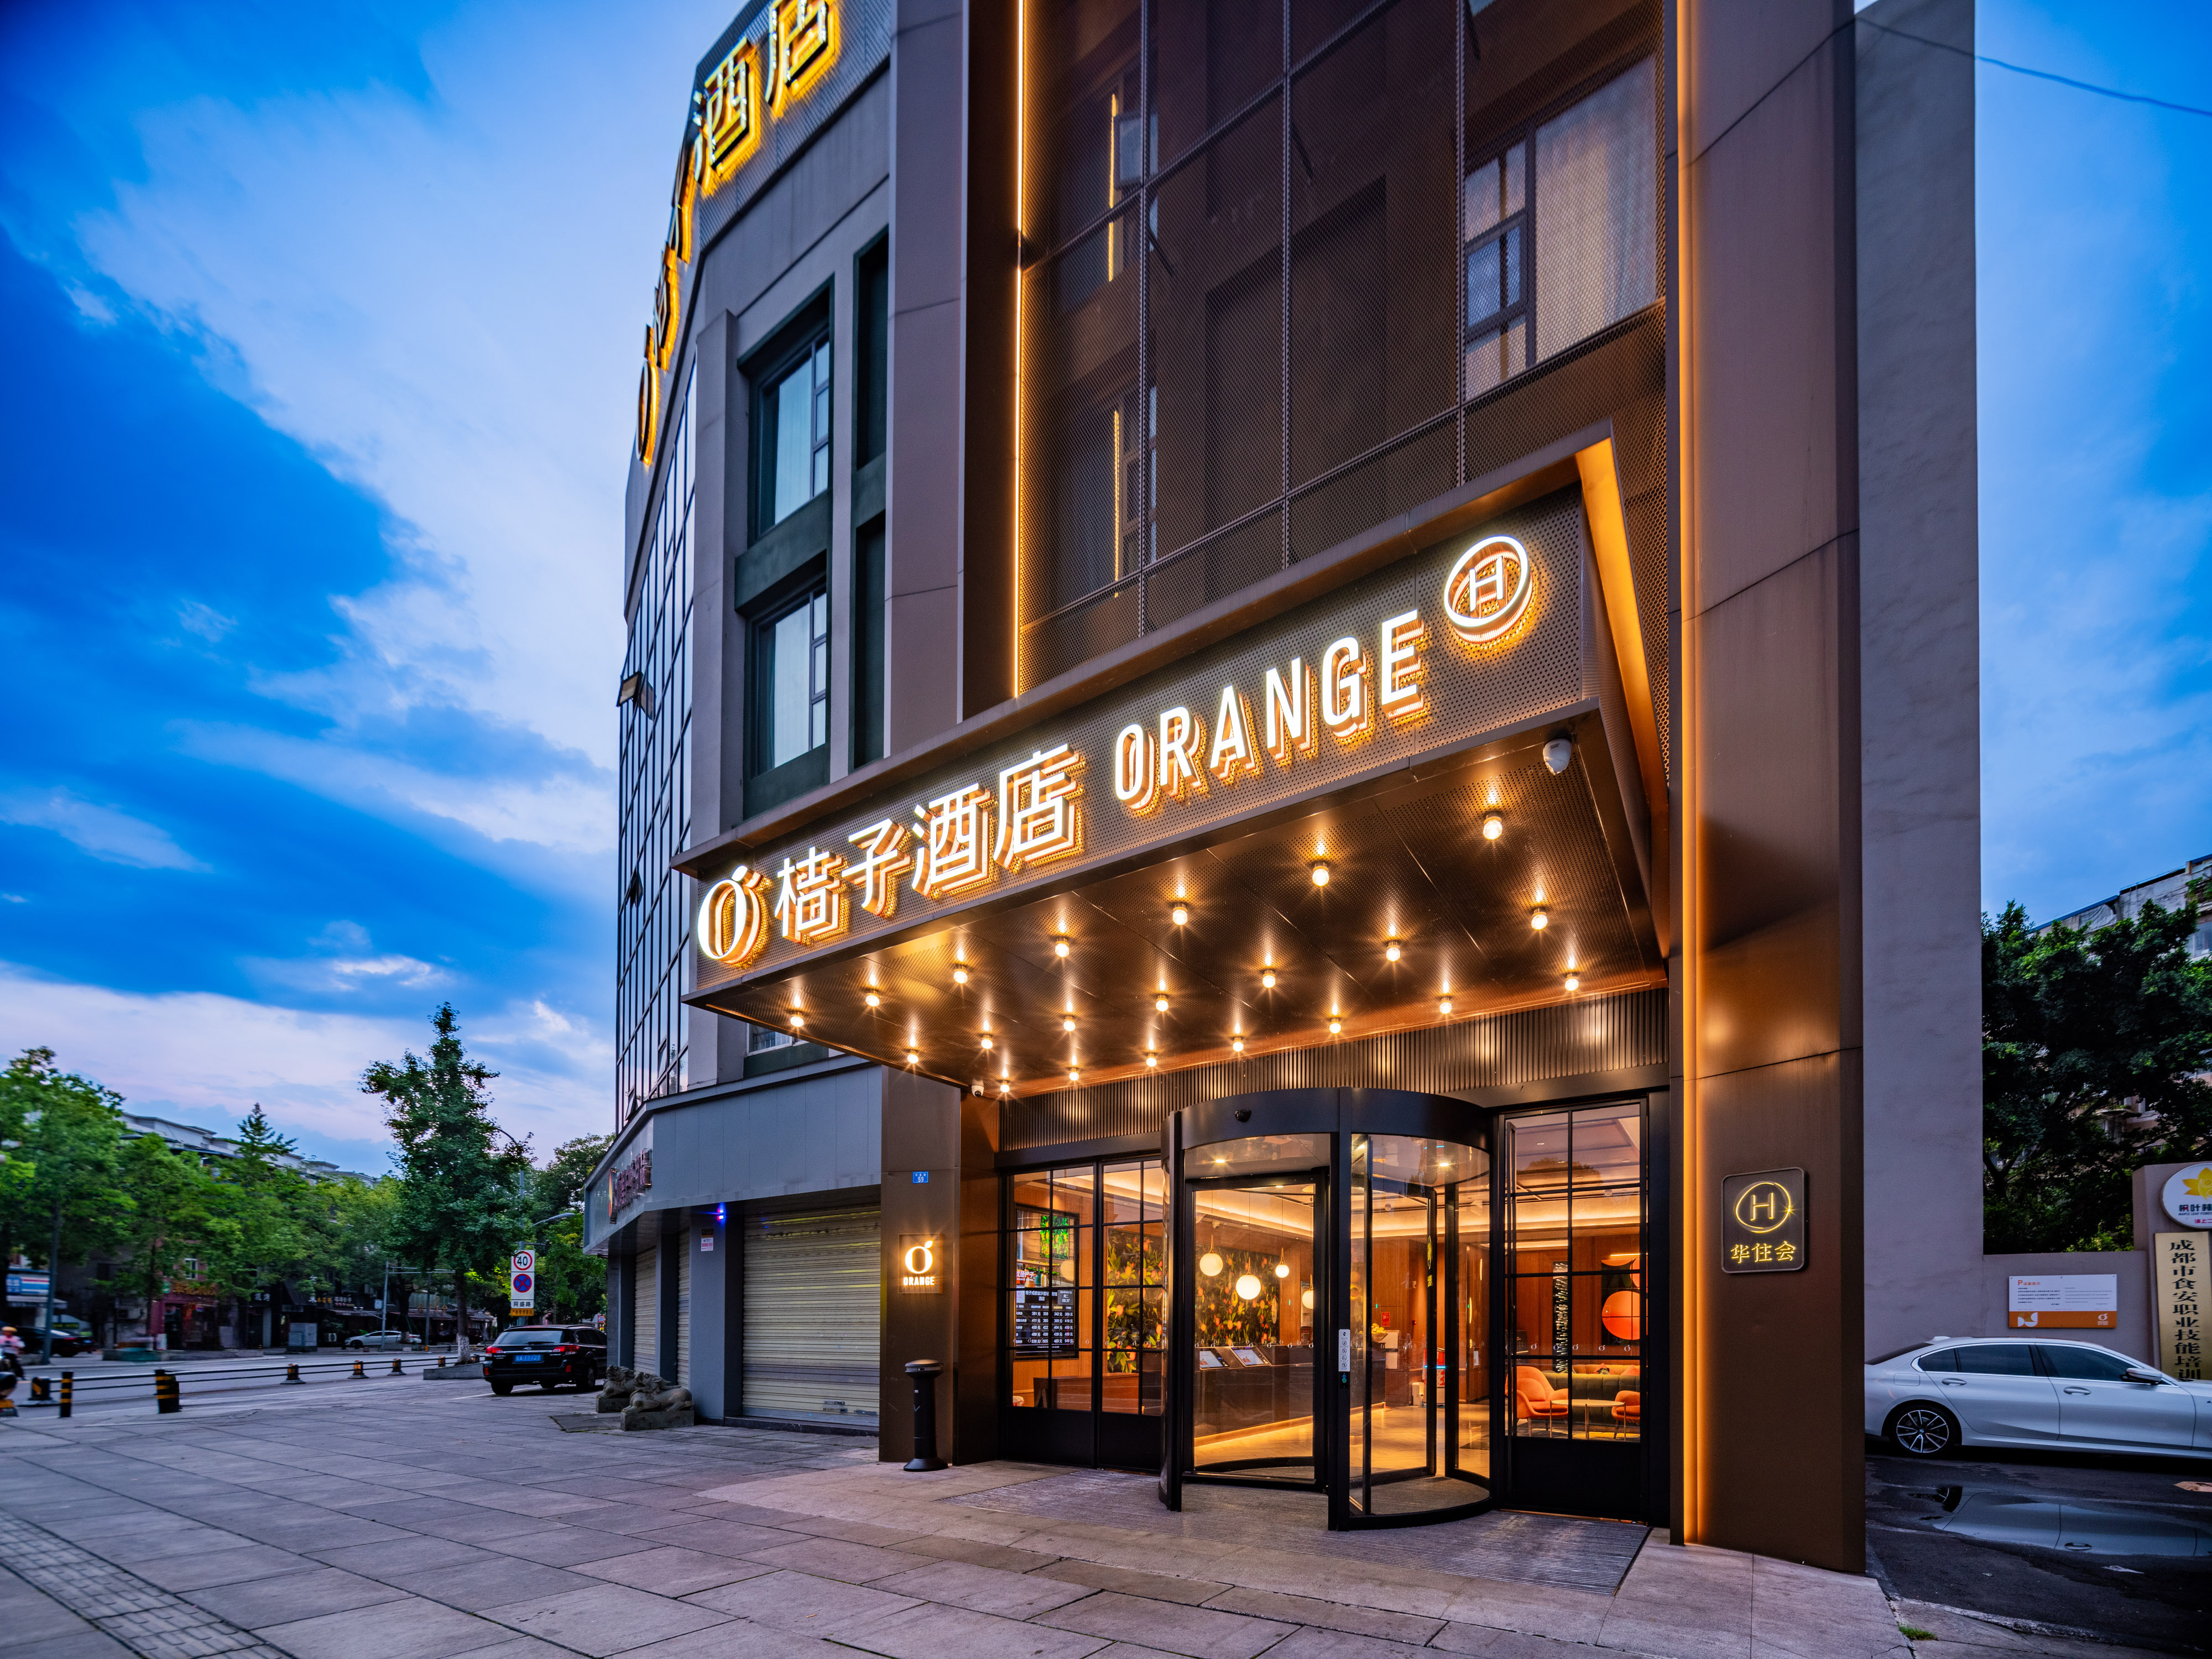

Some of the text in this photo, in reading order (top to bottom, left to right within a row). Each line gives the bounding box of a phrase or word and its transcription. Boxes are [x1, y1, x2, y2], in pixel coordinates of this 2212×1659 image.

[1115, 609, 1421, 805] ORANGE
[775, 743, 1076, 940] 桔子酒店
[517, 1256, 528, 1266] 40
[903, 1276, 935, 1286] ORANGE
[1730, 1240, 1796, 1264] 华住会
[2169, 1239, 2201, 1380] 成都市食安职业技能培训
